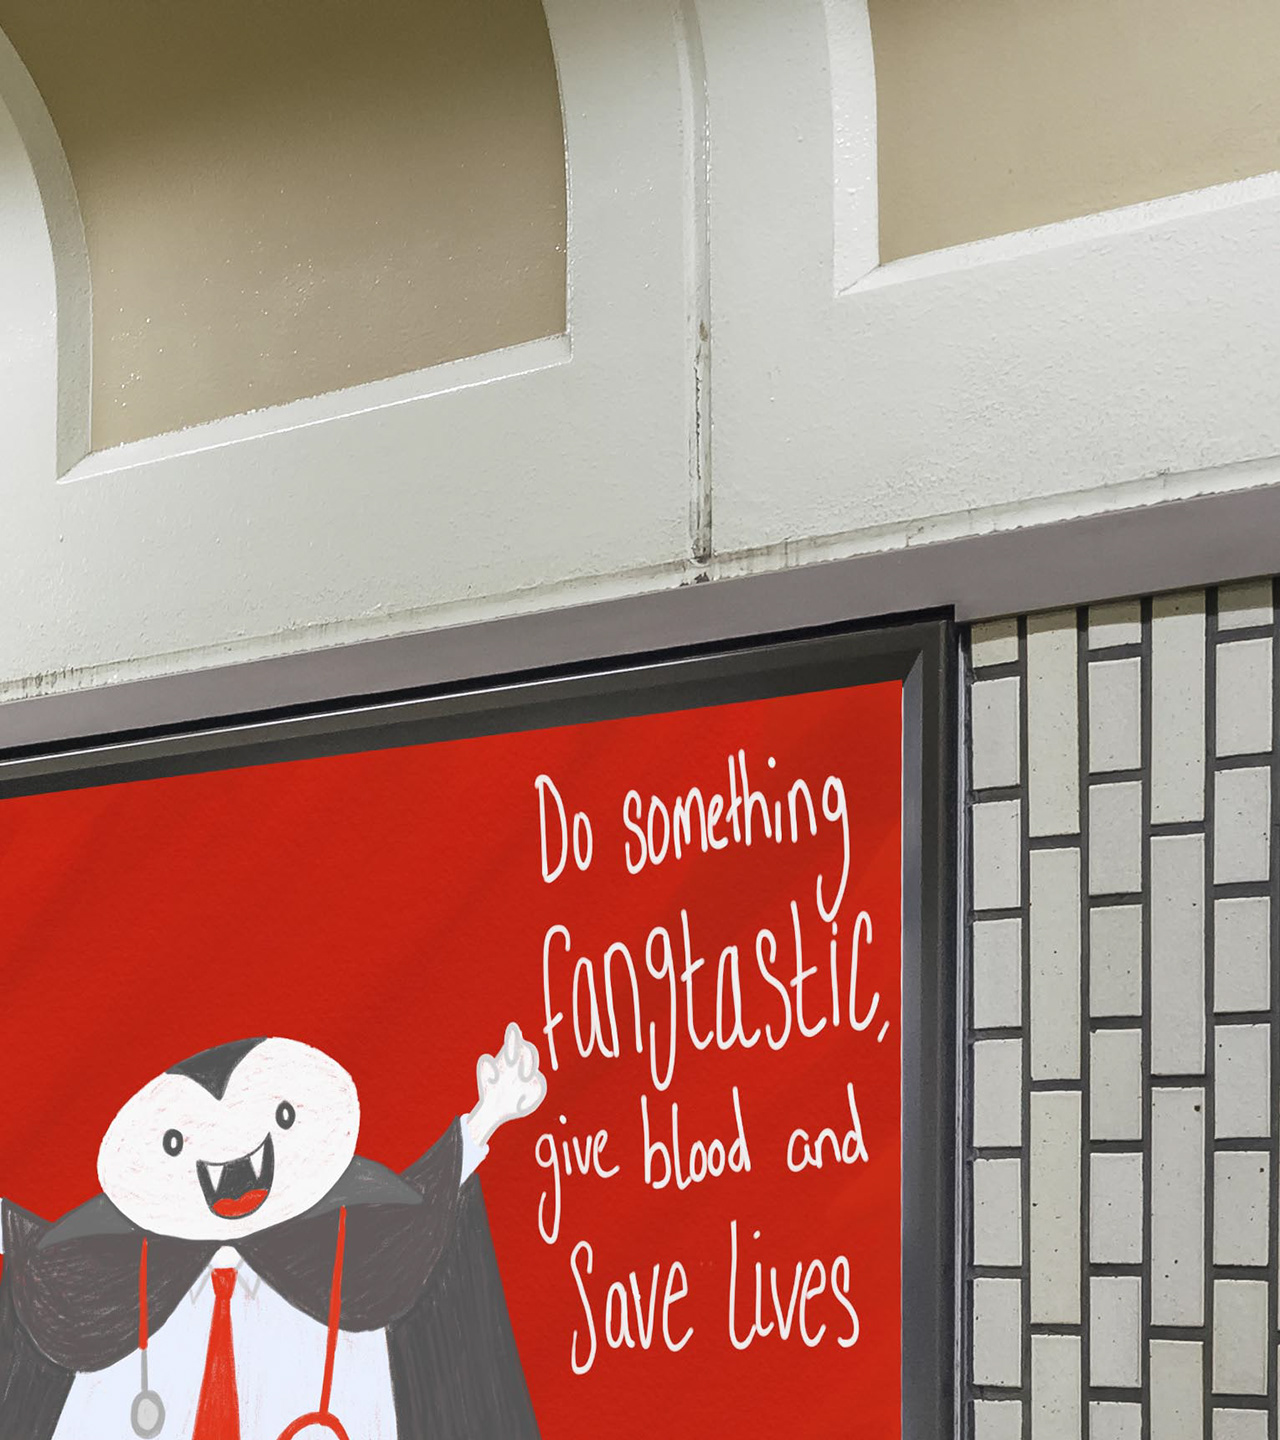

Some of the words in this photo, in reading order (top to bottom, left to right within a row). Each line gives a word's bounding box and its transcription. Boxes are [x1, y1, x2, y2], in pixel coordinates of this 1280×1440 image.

[531, 774, 593, 883] Do
[623, 749, 850, 922] something
[535, 1115, 620, 1244] give
[641, 1086, 751, 1190] blood
[787, 1082, 869, 1172] and
